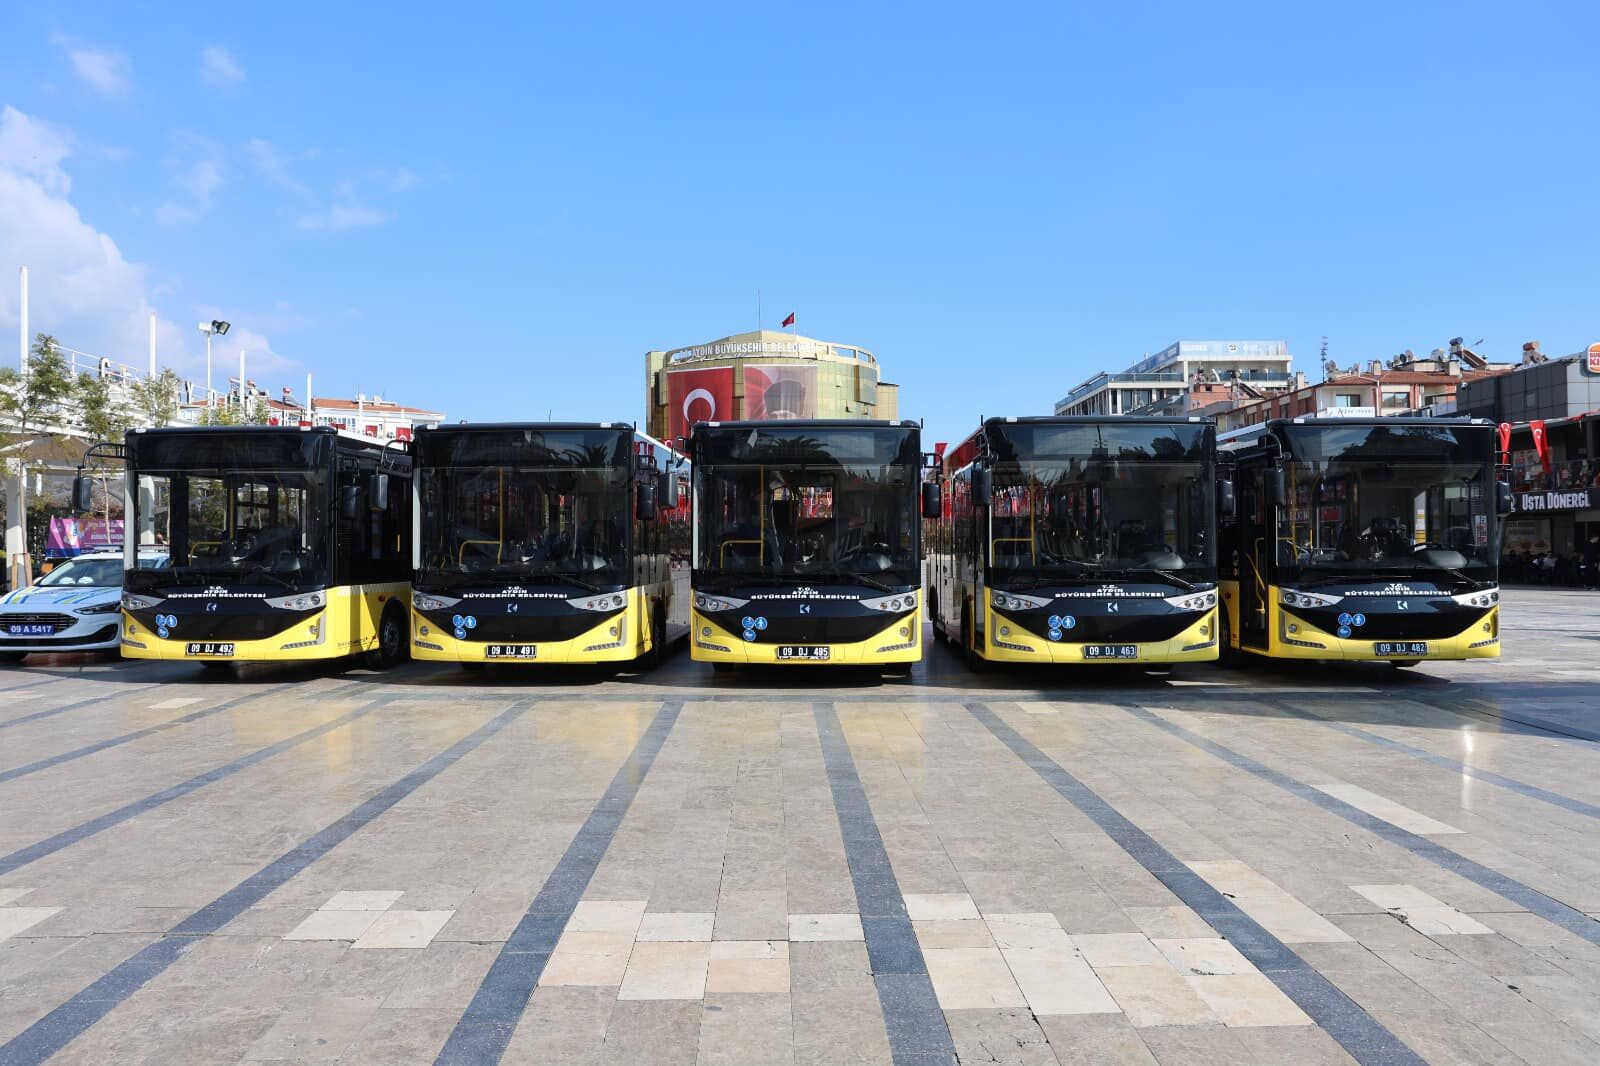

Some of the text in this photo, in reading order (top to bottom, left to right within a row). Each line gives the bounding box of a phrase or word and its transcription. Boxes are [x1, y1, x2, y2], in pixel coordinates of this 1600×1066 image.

[692, 345, 713, 358] AYDIN
[1522, 494, 1545, 510] USTA
[11, 625, 52, 633] 09 A 5417
[191, 643, 233, 653] 09 DJ 492
[491, 646, 534, 655] 09 DJ 491
[782, 647, 793, 656] 09
[798, 647, 808, 656] DJ
[1089, 646, 1100, 656] 09
[1105, 646, 1115, 656] DJ
[1380, 643, 1425, 652] 09 DJ 482
